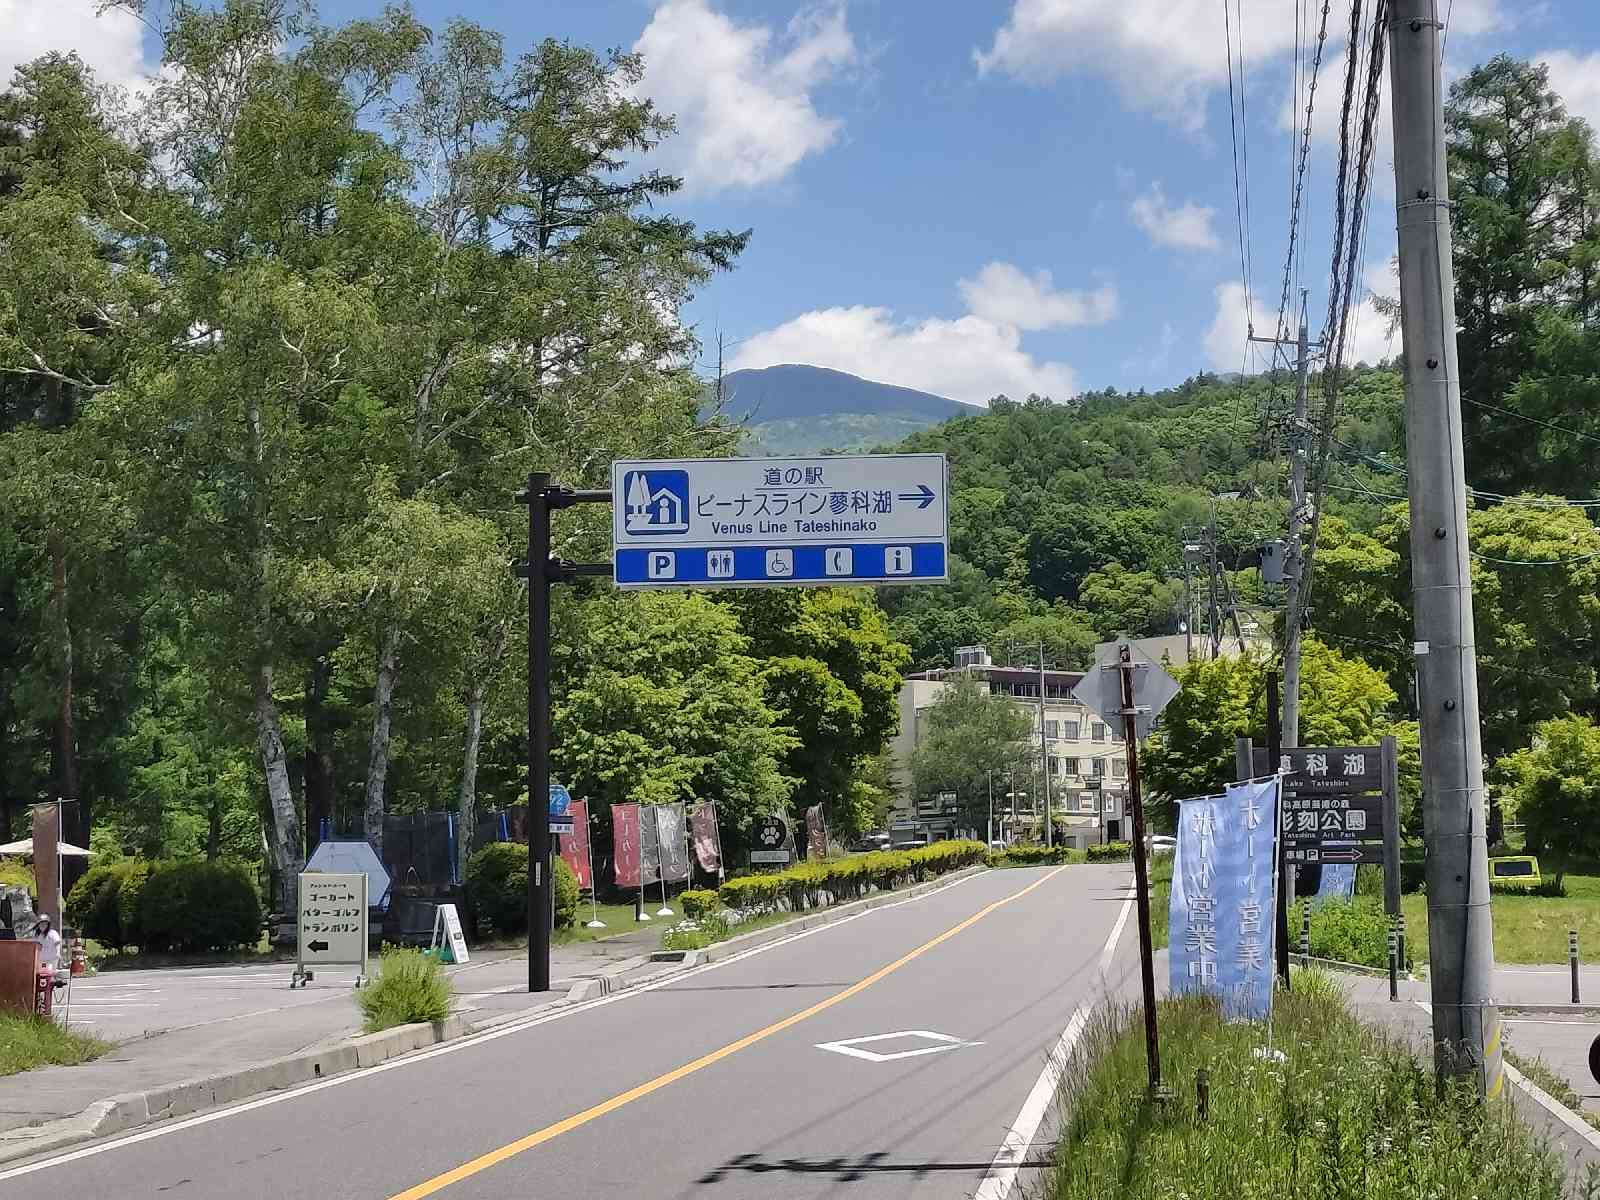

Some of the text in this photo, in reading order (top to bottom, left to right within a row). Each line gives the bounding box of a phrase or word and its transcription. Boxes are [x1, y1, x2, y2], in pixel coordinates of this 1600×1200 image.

[763, 467, 824, 486] 道の駅
[697, 490, 892, 517] ビーナスライン蓼科湖
[711, 520, 878, 535] Venus Line Tateshinako
[654, 555, 671, 575] P
